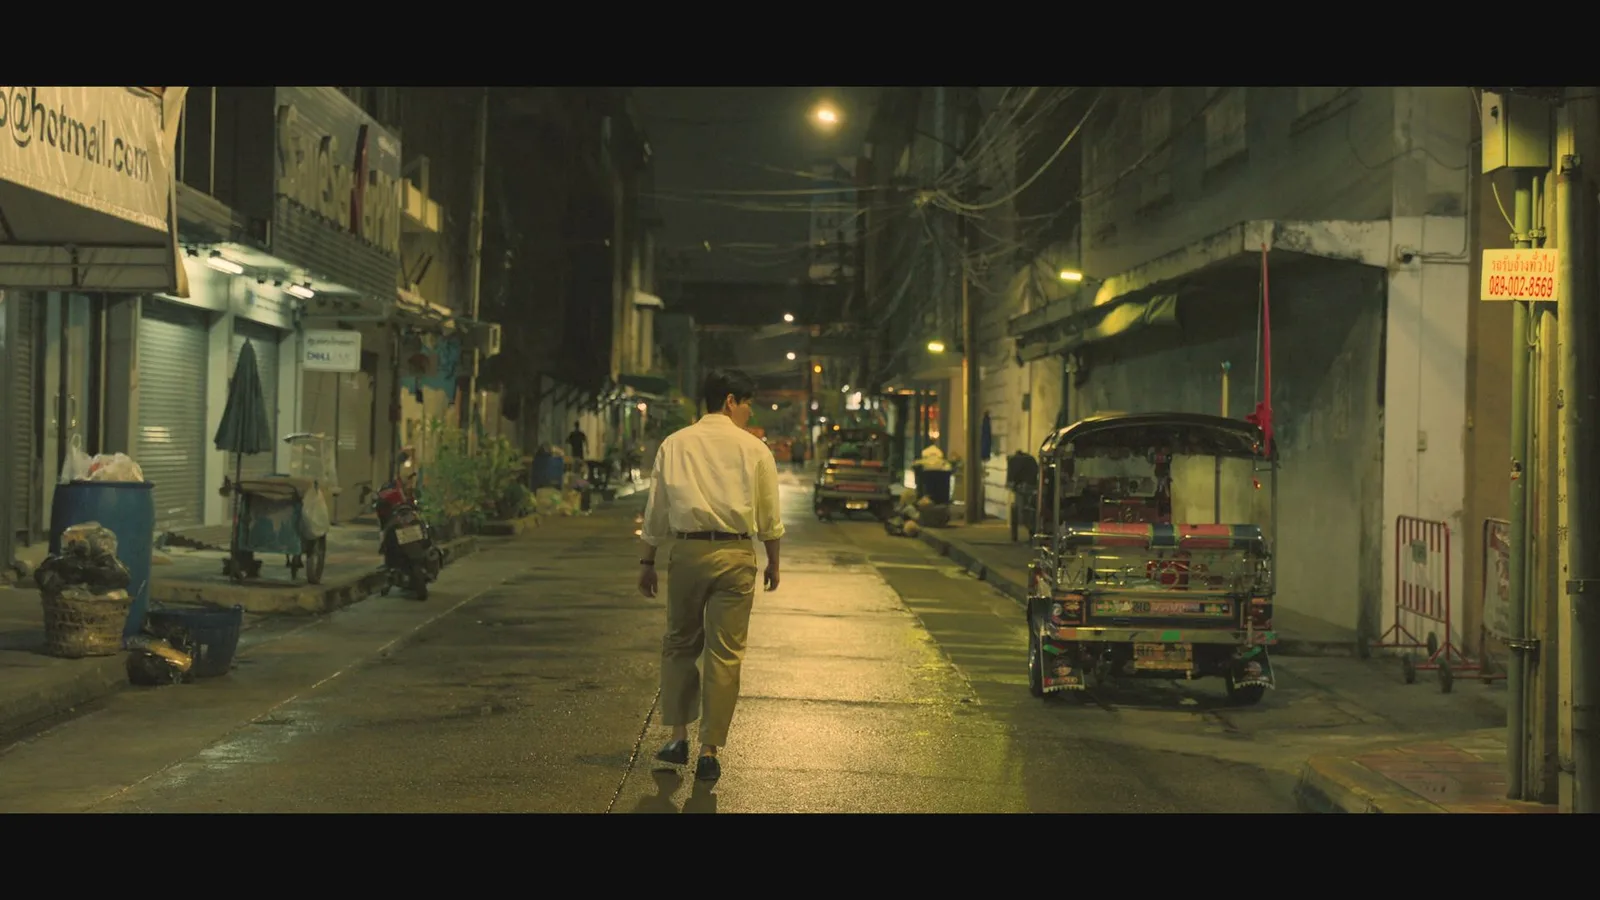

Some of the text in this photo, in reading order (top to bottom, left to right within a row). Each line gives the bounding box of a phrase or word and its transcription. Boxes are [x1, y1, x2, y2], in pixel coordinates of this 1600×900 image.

[1492, 250, 1555, 273] รถรับจ้างทั่วไป
[1489, 275, 1554, 298] 089-002-8569
